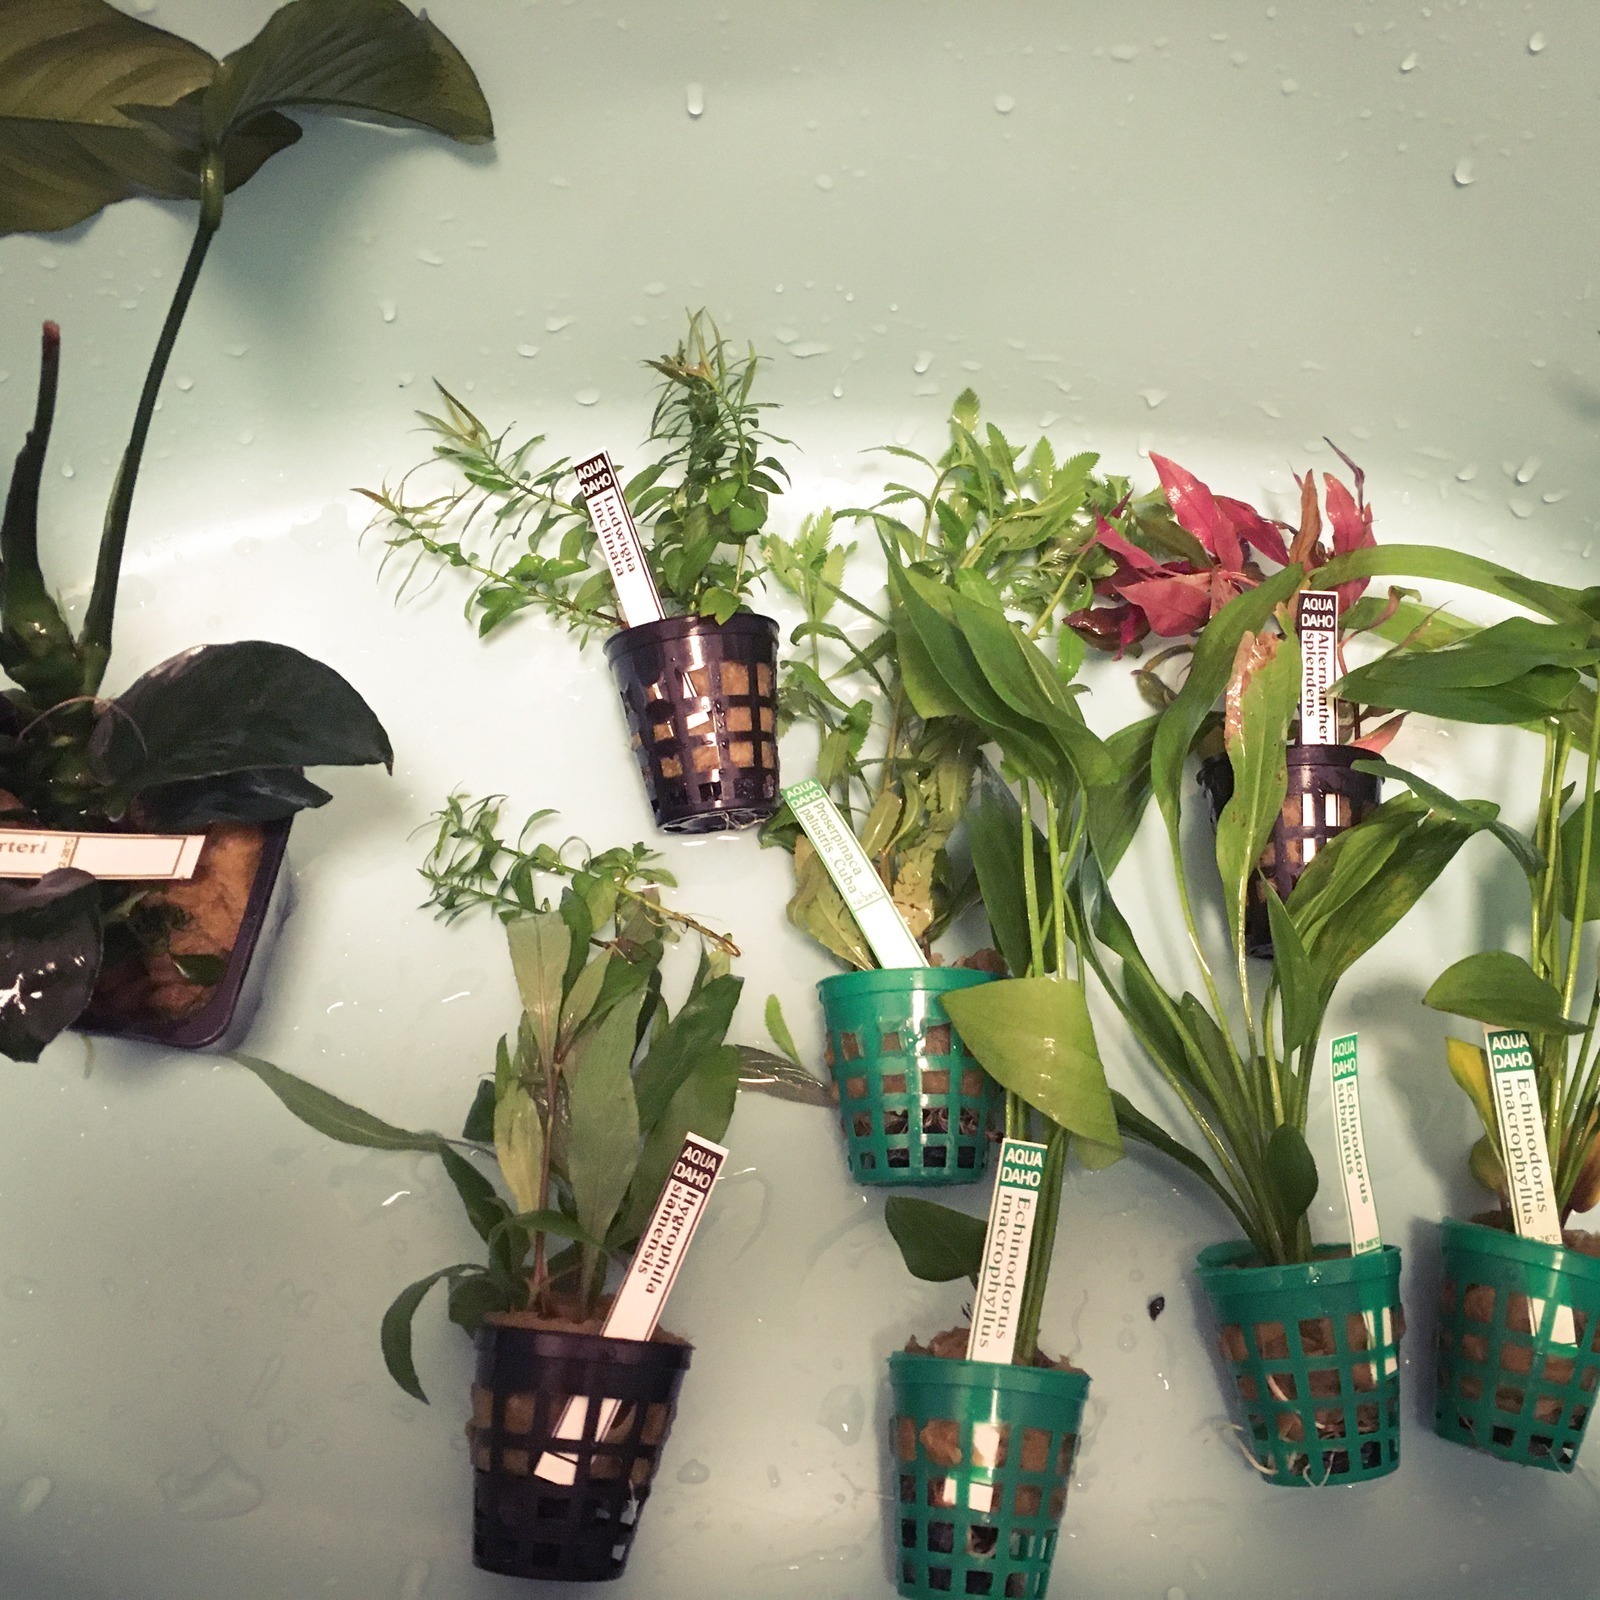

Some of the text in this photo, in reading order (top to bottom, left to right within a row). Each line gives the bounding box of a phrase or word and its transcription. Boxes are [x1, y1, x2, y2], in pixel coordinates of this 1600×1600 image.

[577, 458, 606, 482] AQUA
[582, 473, 611, 497] DAHO
[593, 501, 624, 576] inclinata
[604, 494, 635, 573] Ludwigia
[1302, 614, 1334, 628] DAHO
[1303, 598, 1333, 611] AQUA
[1304, 632, 1316, 717] splendens
[1318, 633, 1330, 746] Alternanther
[787, 781, 817, 800] AQUA
[792, 790, 822, 808] DAHO
[800, 809, 833, 853] palustris
[813, 801, 862, 876] Proserpinaca
[1333, 1040, 1355, 1057] AQUA
[1492, 1033, 1529, 1050] AQUA
[1333, 1057, 1356, 1077] DAHO
[1493, 1051, 1532, 1069] DAHO
[1337, 1083, 1354, 1175] subalatus
[1346, 1081, 1368, 1204] Echinodorus
[1517, 1078, 1547, 1213] Echinodorus
[682, 1146, 716, 1171] AQUA
[1005, 1147, 1043, 1167] AQUA
[1502, 1079, 1534, 1225] macrophyllus
[674, 1162, 711, 1189] DAHO
[1001, 1167, 1041, 1187] DAHO
[638, 1183, 682, 1275] siamensis
[645, 1190, 699, 1294] Hygrophila
[979, 1194, 1013, 1348] macrophyllus
[996, 1196, 1031, 1339] Echinodorus
